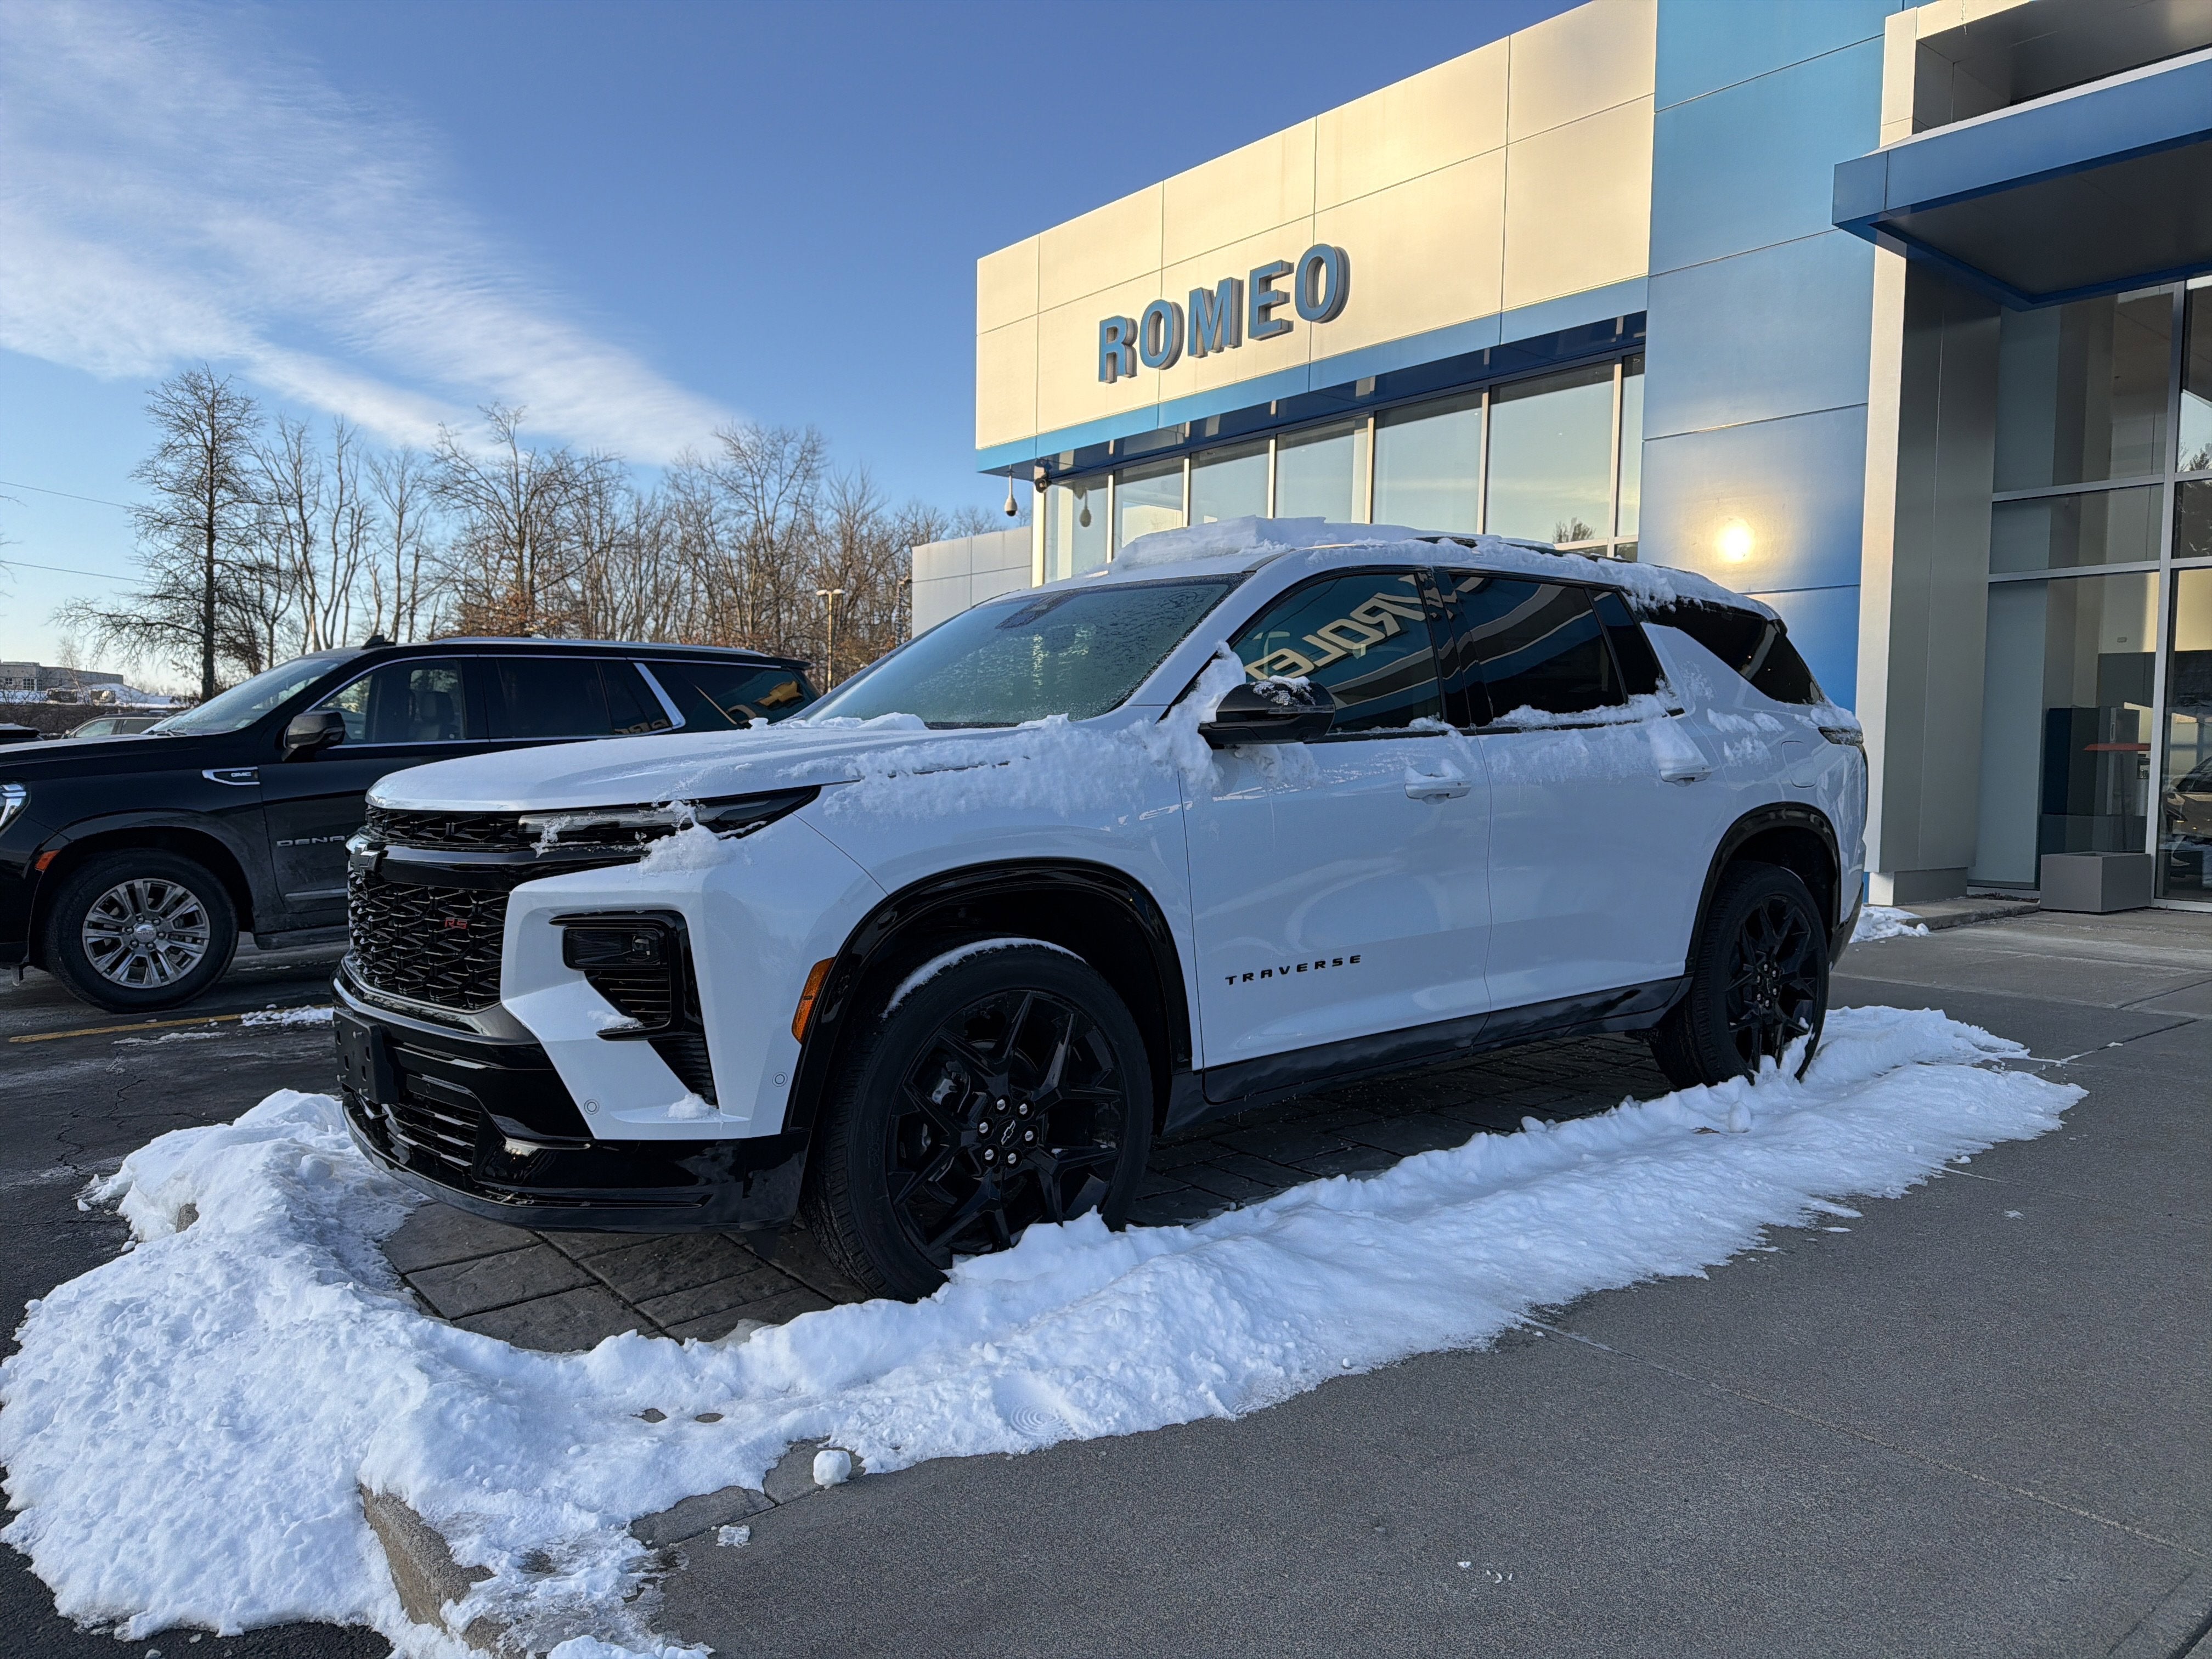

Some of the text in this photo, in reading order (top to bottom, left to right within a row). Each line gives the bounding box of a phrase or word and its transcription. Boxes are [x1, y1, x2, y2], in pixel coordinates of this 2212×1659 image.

[1098, 244, 1350, 383] ROMEO
[276, 835, 349, 847] DENA
[444, 918, 467, 929] RS
[1225, 955, 1361, 985] TRAVERSE
